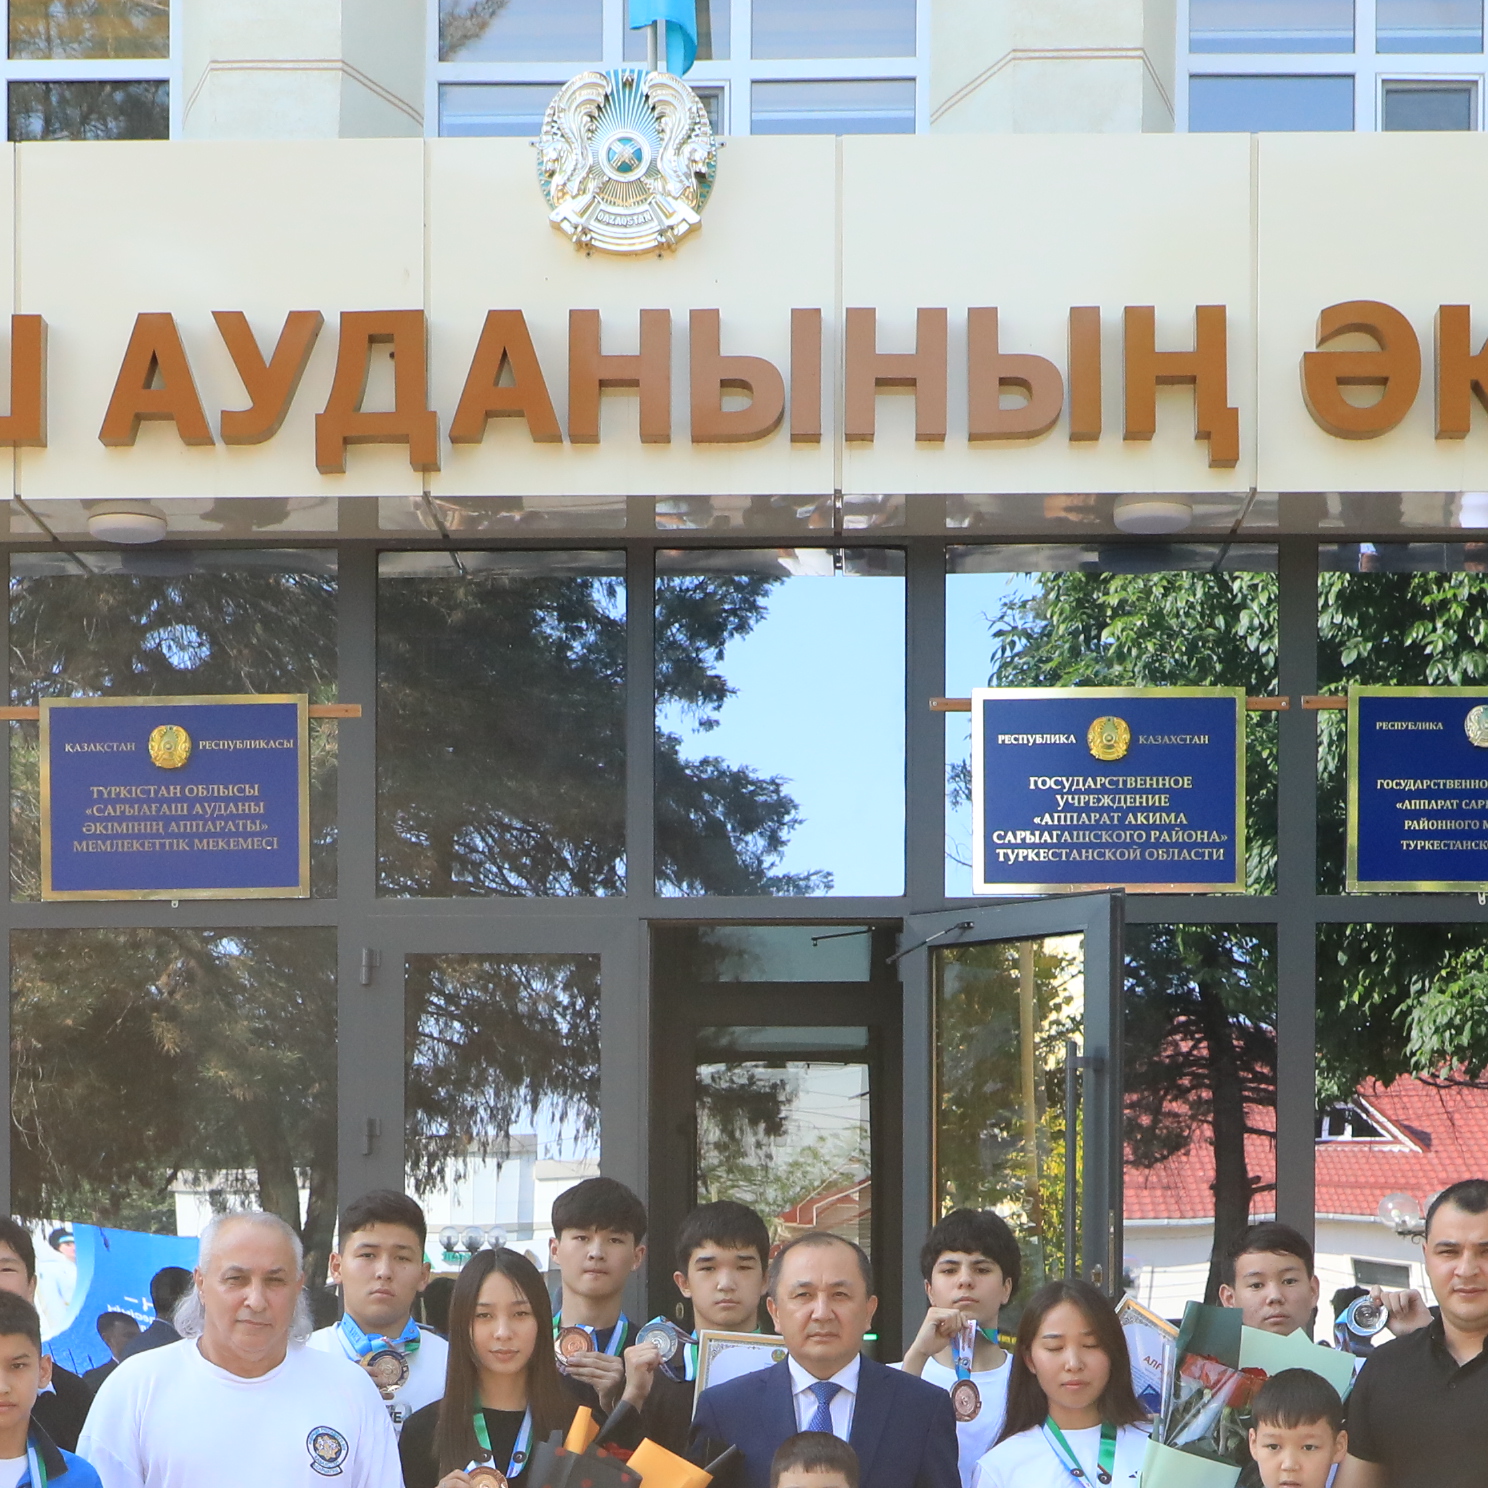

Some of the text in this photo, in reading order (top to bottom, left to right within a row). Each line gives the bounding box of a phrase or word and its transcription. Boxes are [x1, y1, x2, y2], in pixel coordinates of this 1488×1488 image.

[98, 305, 1241, 476] АУДАНЫНЫҢ
[1376, 722, 1443, 730] РЕСПУБЛИКА
[65, 739, 293, 753] ҚАЗАҚСТАН РЕСПУБЛИКАСЫ
[998, 734, 1209, 746] РЕСПУБЛИКА КАЗАХСТАН
[1029, 776, 1192, 791] ГОСУДАРСТВЕННОЕ
[90, 784, 259, 798] ТҮРКІСТАН ОБЛЫСЫ
[1056, 794, 1169, 810] УЧРЕЖДЕНИЕ
[1396, 800, 1459, 809] «АППАРАТ
[86, 802, 264, 817] «САРЫАҒАШ АУДАНЫ
[1033, 812, 1188, 825] «АППАРАТ АКИМА
[1404, 818, 1479, 830] РАЙОННОГО
[82, 820, 268, 835] ӘКІМІНІҢ АППАРАТЫ»
[993, 827, 1228, 844] САРЫАГАШСКОГО РАЙОНА»
[73, 838, 278, 852] МЕМЛЕКЕТТІК МЕКЕМЕСІ
[997, 846, 1224, 864] ТУРКЕСТАНСКОЙ ОБЛАСТИ
